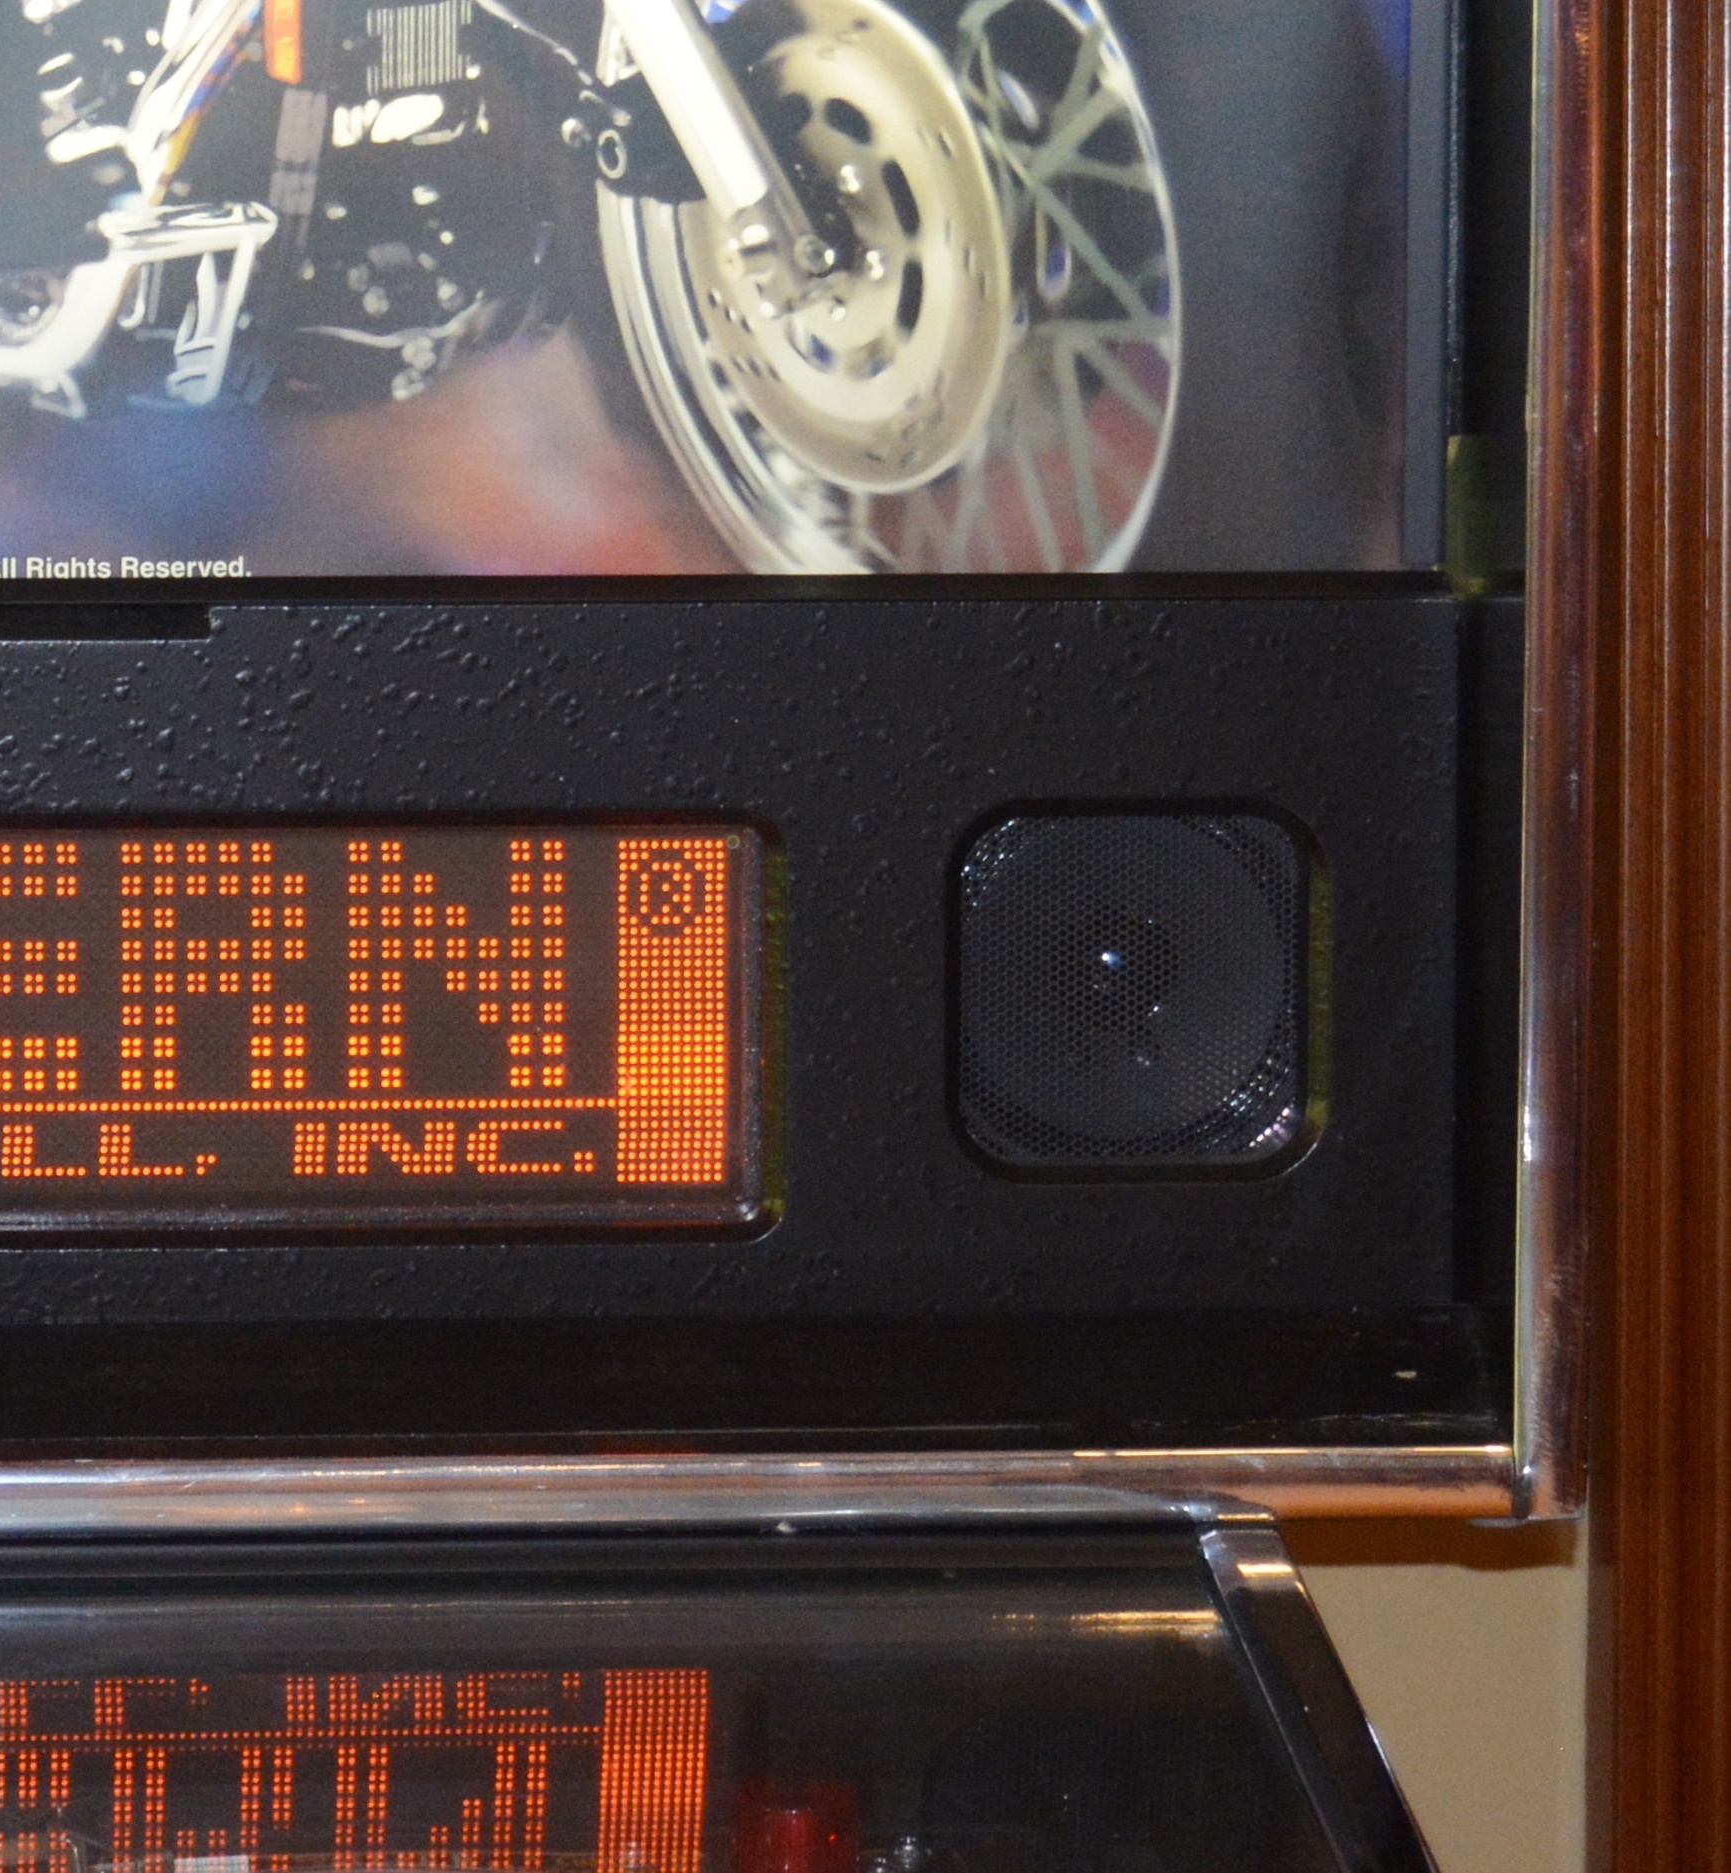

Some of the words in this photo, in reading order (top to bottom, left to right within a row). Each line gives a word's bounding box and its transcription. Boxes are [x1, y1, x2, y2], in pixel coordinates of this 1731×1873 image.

[25, 557, 112, 579] Rights
[120, 556, 253, 578] Reserved.
[289, 1119, 598, 1178] INC.
